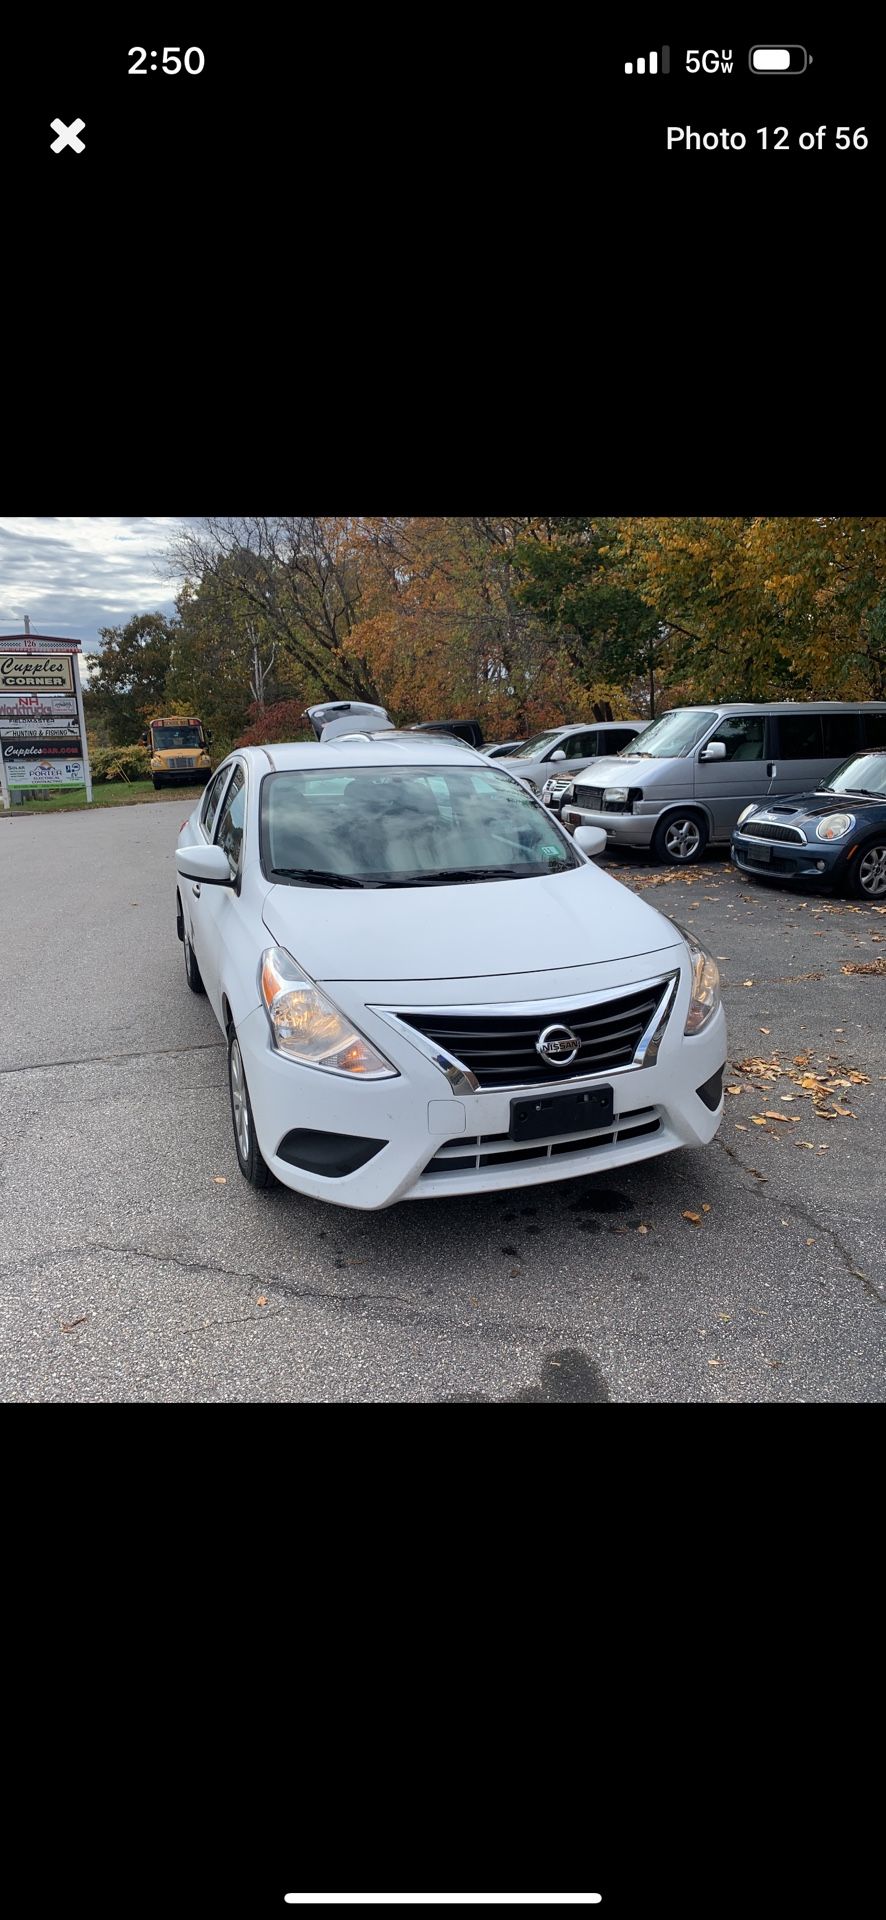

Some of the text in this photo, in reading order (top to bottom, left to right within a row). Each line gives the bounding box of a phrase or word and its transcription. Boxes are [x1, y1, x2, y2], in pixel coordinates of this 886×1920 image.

[1, 657, 64, 675] Cupples
[5, 677, 63, 685] CORNER
[18, 698, 39, 706] NH
[542, 1041, 578, 1052] NISSAN
